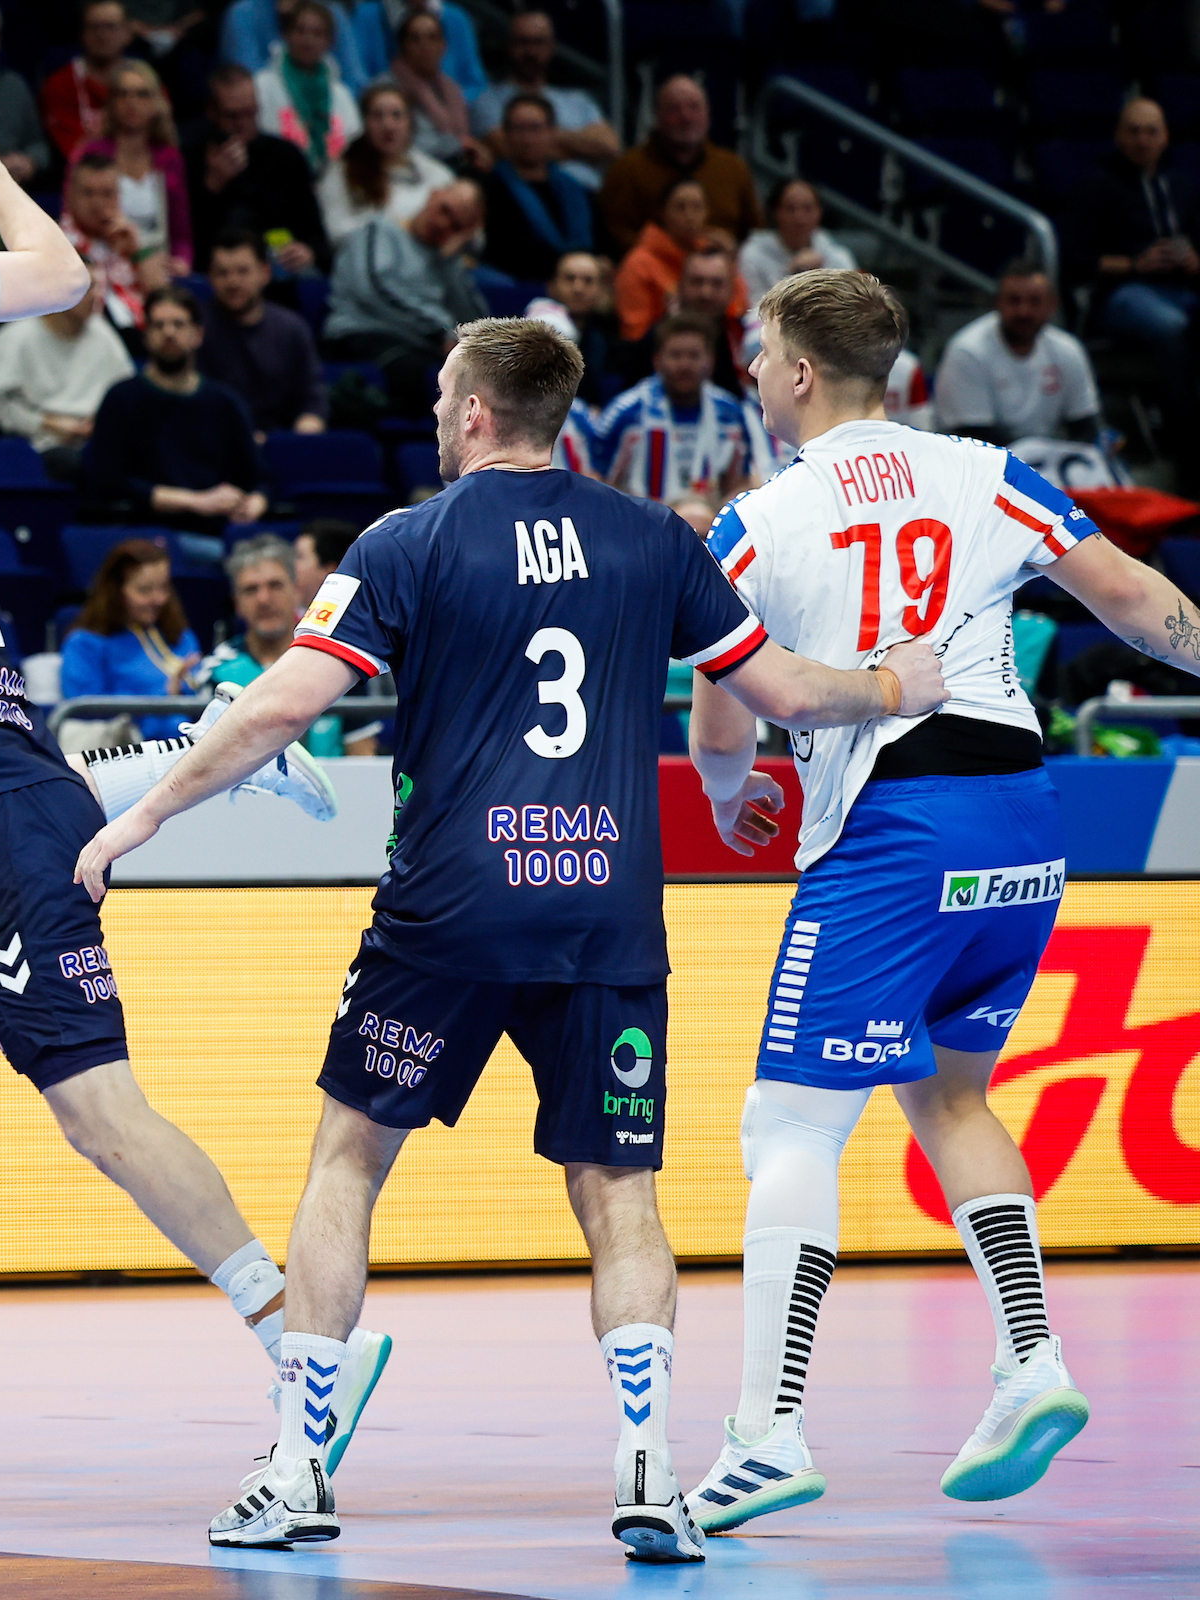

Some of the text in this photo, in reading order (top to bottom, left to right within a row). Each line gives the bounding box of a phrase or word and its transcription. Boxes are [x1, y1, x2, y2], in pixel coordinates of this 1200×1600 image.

[833, 451, 916, 506] HORN
[514, 516, 589, 585] AGA
[829, 518, 952, 652] 79
[523, 627, 587, 759] 3
[487, 804, 619, 842] REMA
[504, 848, 610, 887] 1000
[984, 865, 1063, 904] Fønix
[59, 945, 112, 979] REM
[79, 973, 119, 1004] 100
[358, 1012, 445, 1062] REMA
[365, 1044, 428, 1088] 1000
[603, 1091, 654, 1124] bring
